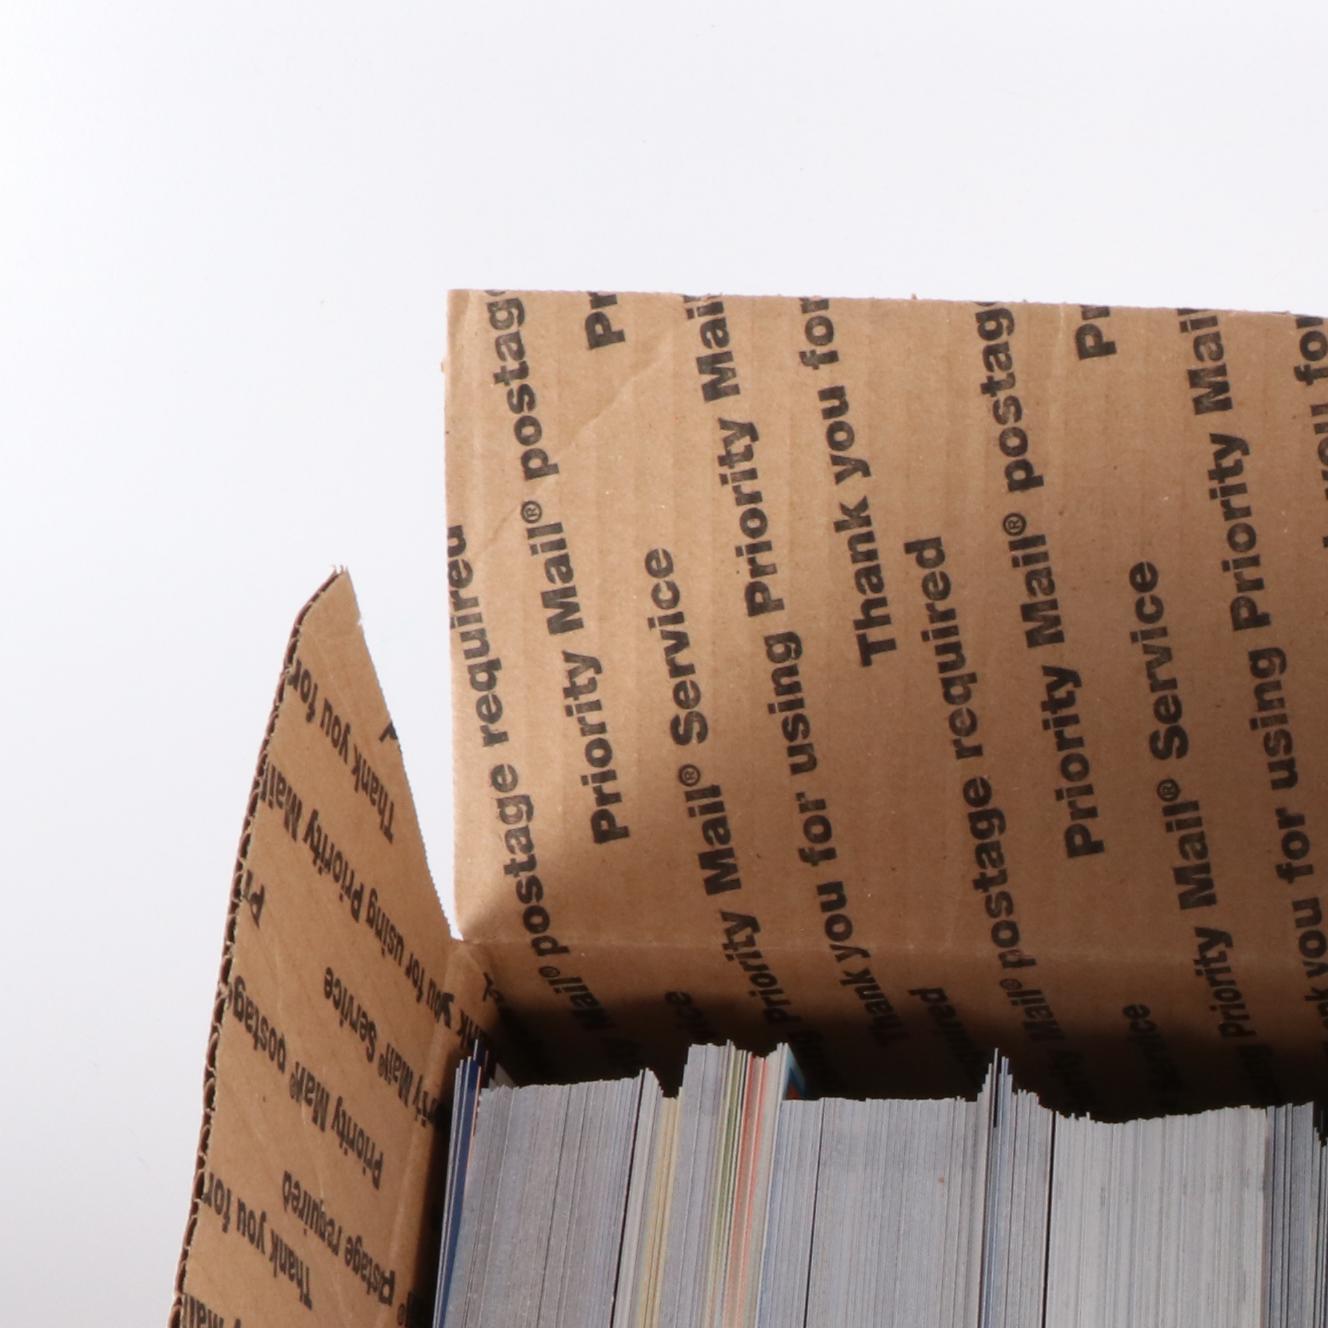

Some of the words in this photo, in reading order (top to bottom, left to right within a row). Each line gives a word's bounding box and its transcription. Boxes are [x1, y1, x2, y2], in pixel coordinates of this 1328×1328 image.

[975, 303, 1044, 492] postag
[1177, 309, 1232, 415] Mai
[818, 386, 871, 485] you
[521, 501, 584, 634] Mail®
[718, 418, 784, 617] Priority
[834, 496, 896, 667] Thank
[1003, 513, 1064, 648] Mail®
[1209, 433, 1271, 631] Priority
[645, 549, 708, 745] Service
[764, 632, 817, 775] using
[904, 537, 983, 759] required
[1129, 562, 1188, 760] Service
[322, 697, 352, 763] you
[562, 651, 630, 844] Priority
[1041, 666, 1104, 858] Priority
[1248, 648, 1298, 790] using
[352, 744, 397, 843] Thank
[678, 764, 741, 896] Mail®
[796, 792, 837, 866] for
[1156, 779, 1217, 910] Mail®
[1275, 807, 1314, 884] for
[303, 808, 364, 923] Priority
[365, 887, 404, 960] using
[491, 765, 570, 956] postage
[816, 881, 870, 962] you
[963, 777, 1036, 968] postage
[231, 975, 287, 1074] postag
[323, 965, 377, 1063] Service
[719, 910, 795, 1023] Priority
[1193, 926, 1256, 1038] Priority
[331, 1096, 384, 1191] Priority
[237, 1197, 268, 1255] you
[269, 1226, 312, 1311] Thank
